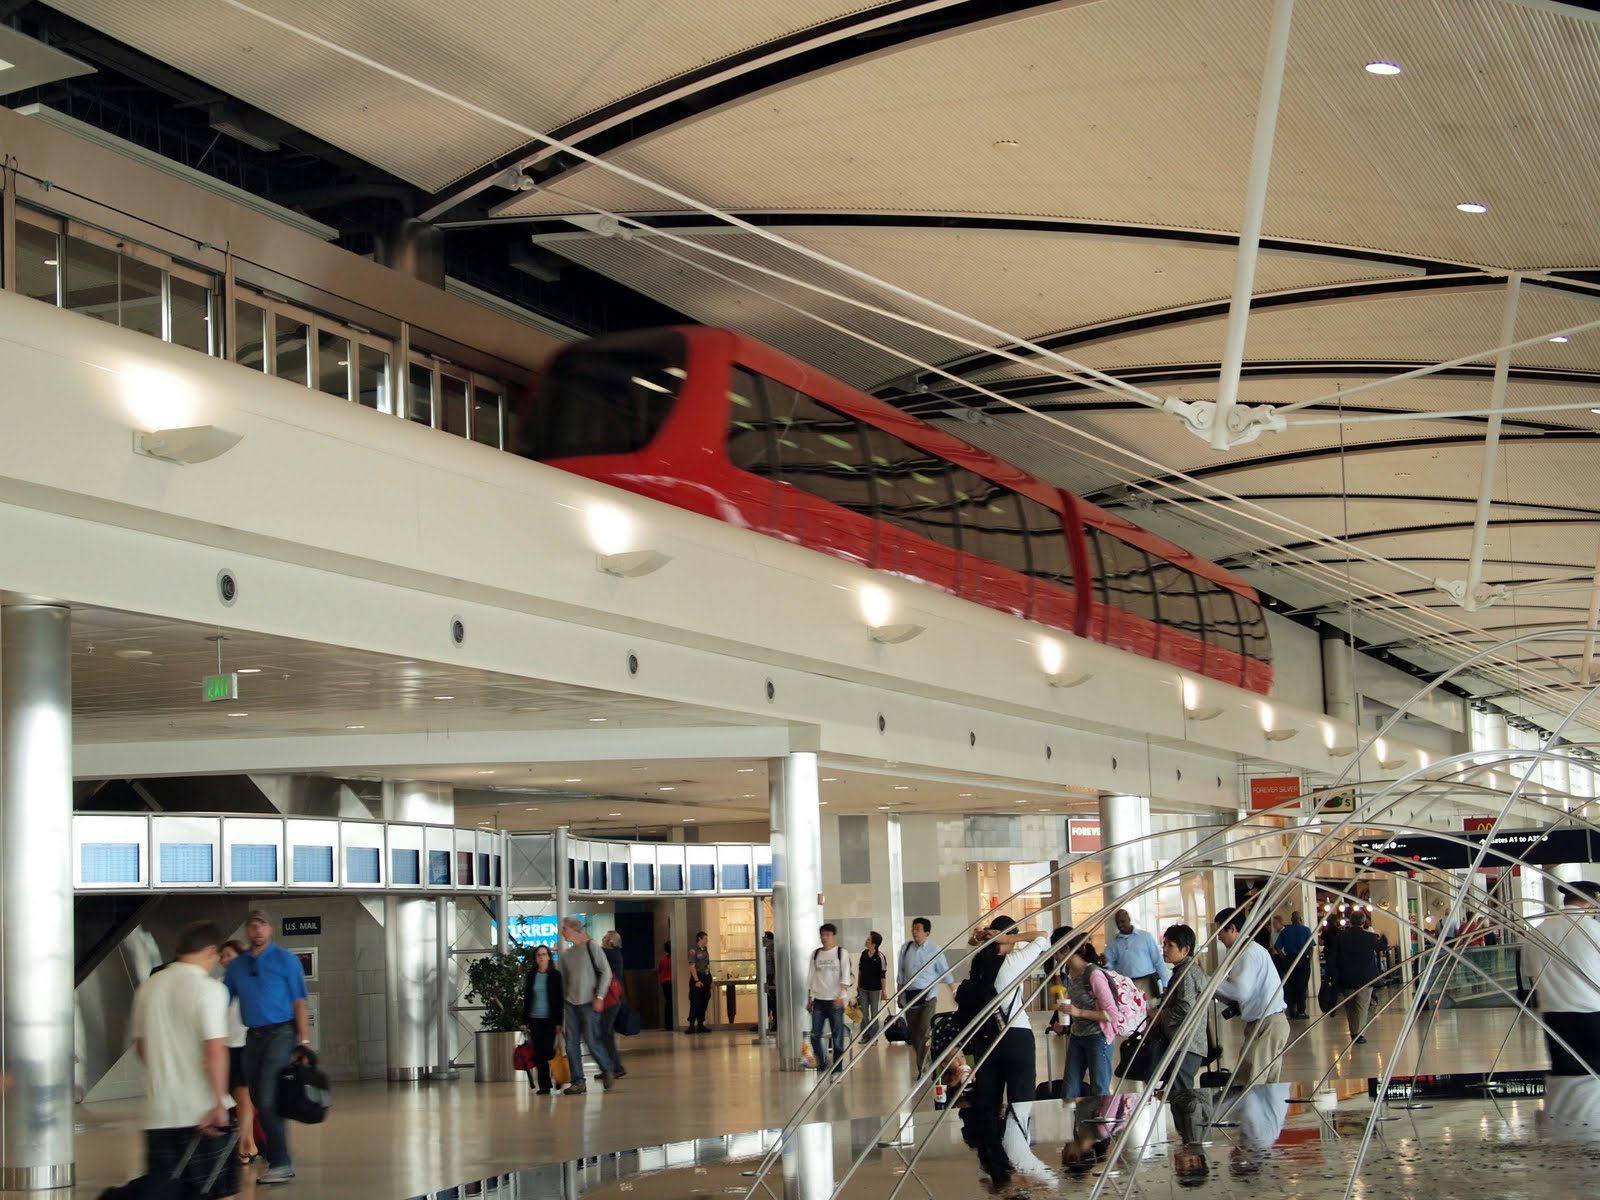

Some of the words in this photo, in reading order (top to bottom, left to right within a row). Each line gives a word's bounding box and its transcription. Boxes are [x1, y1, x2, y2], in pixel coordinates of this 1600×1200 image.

[207, 675, 229, 698] EXIT
[1253, 786, 1278, 794] FOREVER
[1279, 785, 1298, 793] SILVER
[285, 922, 298, 931] U.S.
[299, 921, 318, 930] MAIL
